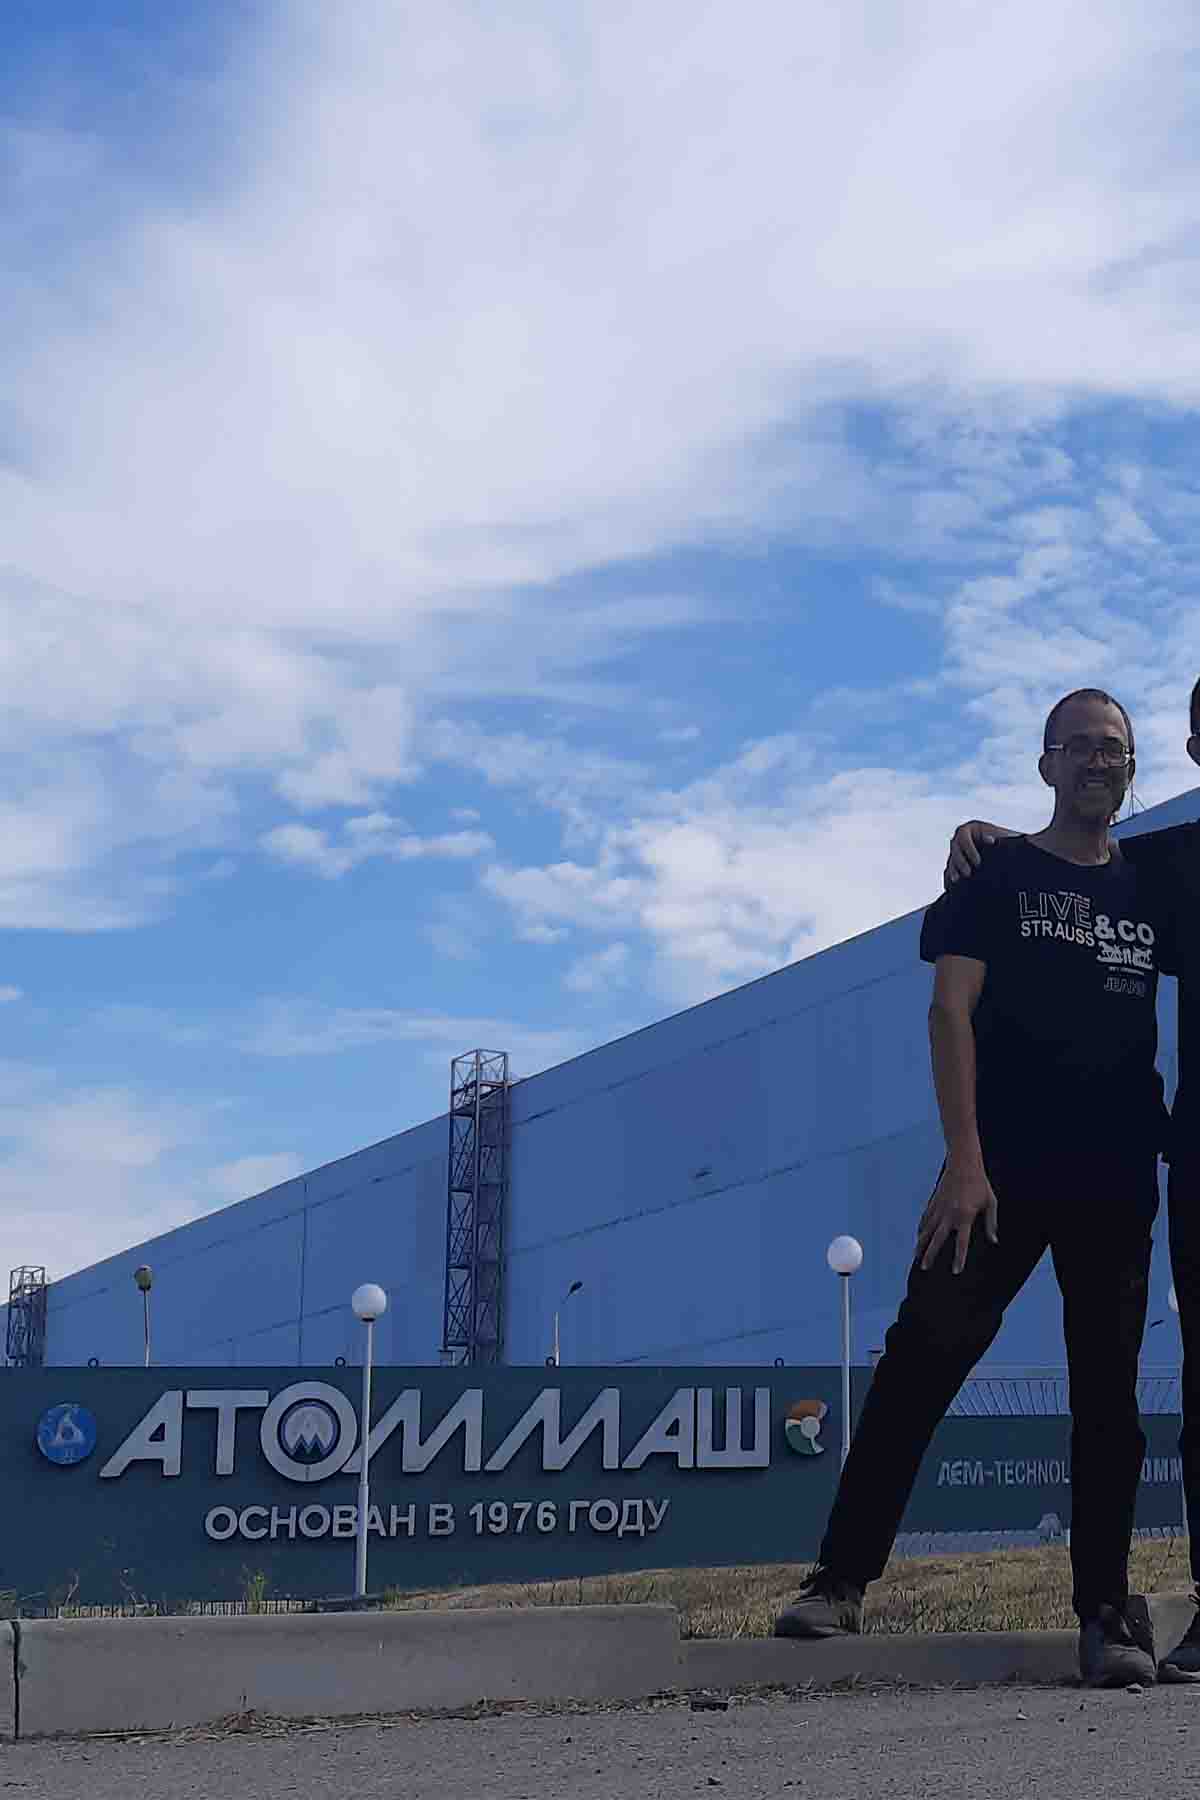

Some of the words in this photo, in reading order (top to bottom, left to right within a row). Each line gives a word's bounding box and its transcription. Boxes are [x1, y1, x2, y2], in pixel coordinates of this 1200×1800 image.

[1020, 919, 1095, 947] STRAUSS
[99, 1380, 771, 1483] АТОММАШ
[936, 1458, 1071, 1487] AEM-TECHNOL
[204, 1502, 416, 1541] ОСНОВАН
[427, 1502, 456, 1537] В
[468, 1500, 558, 1535] 1976
[568, 1498, 671, 1539] ГОДУ
